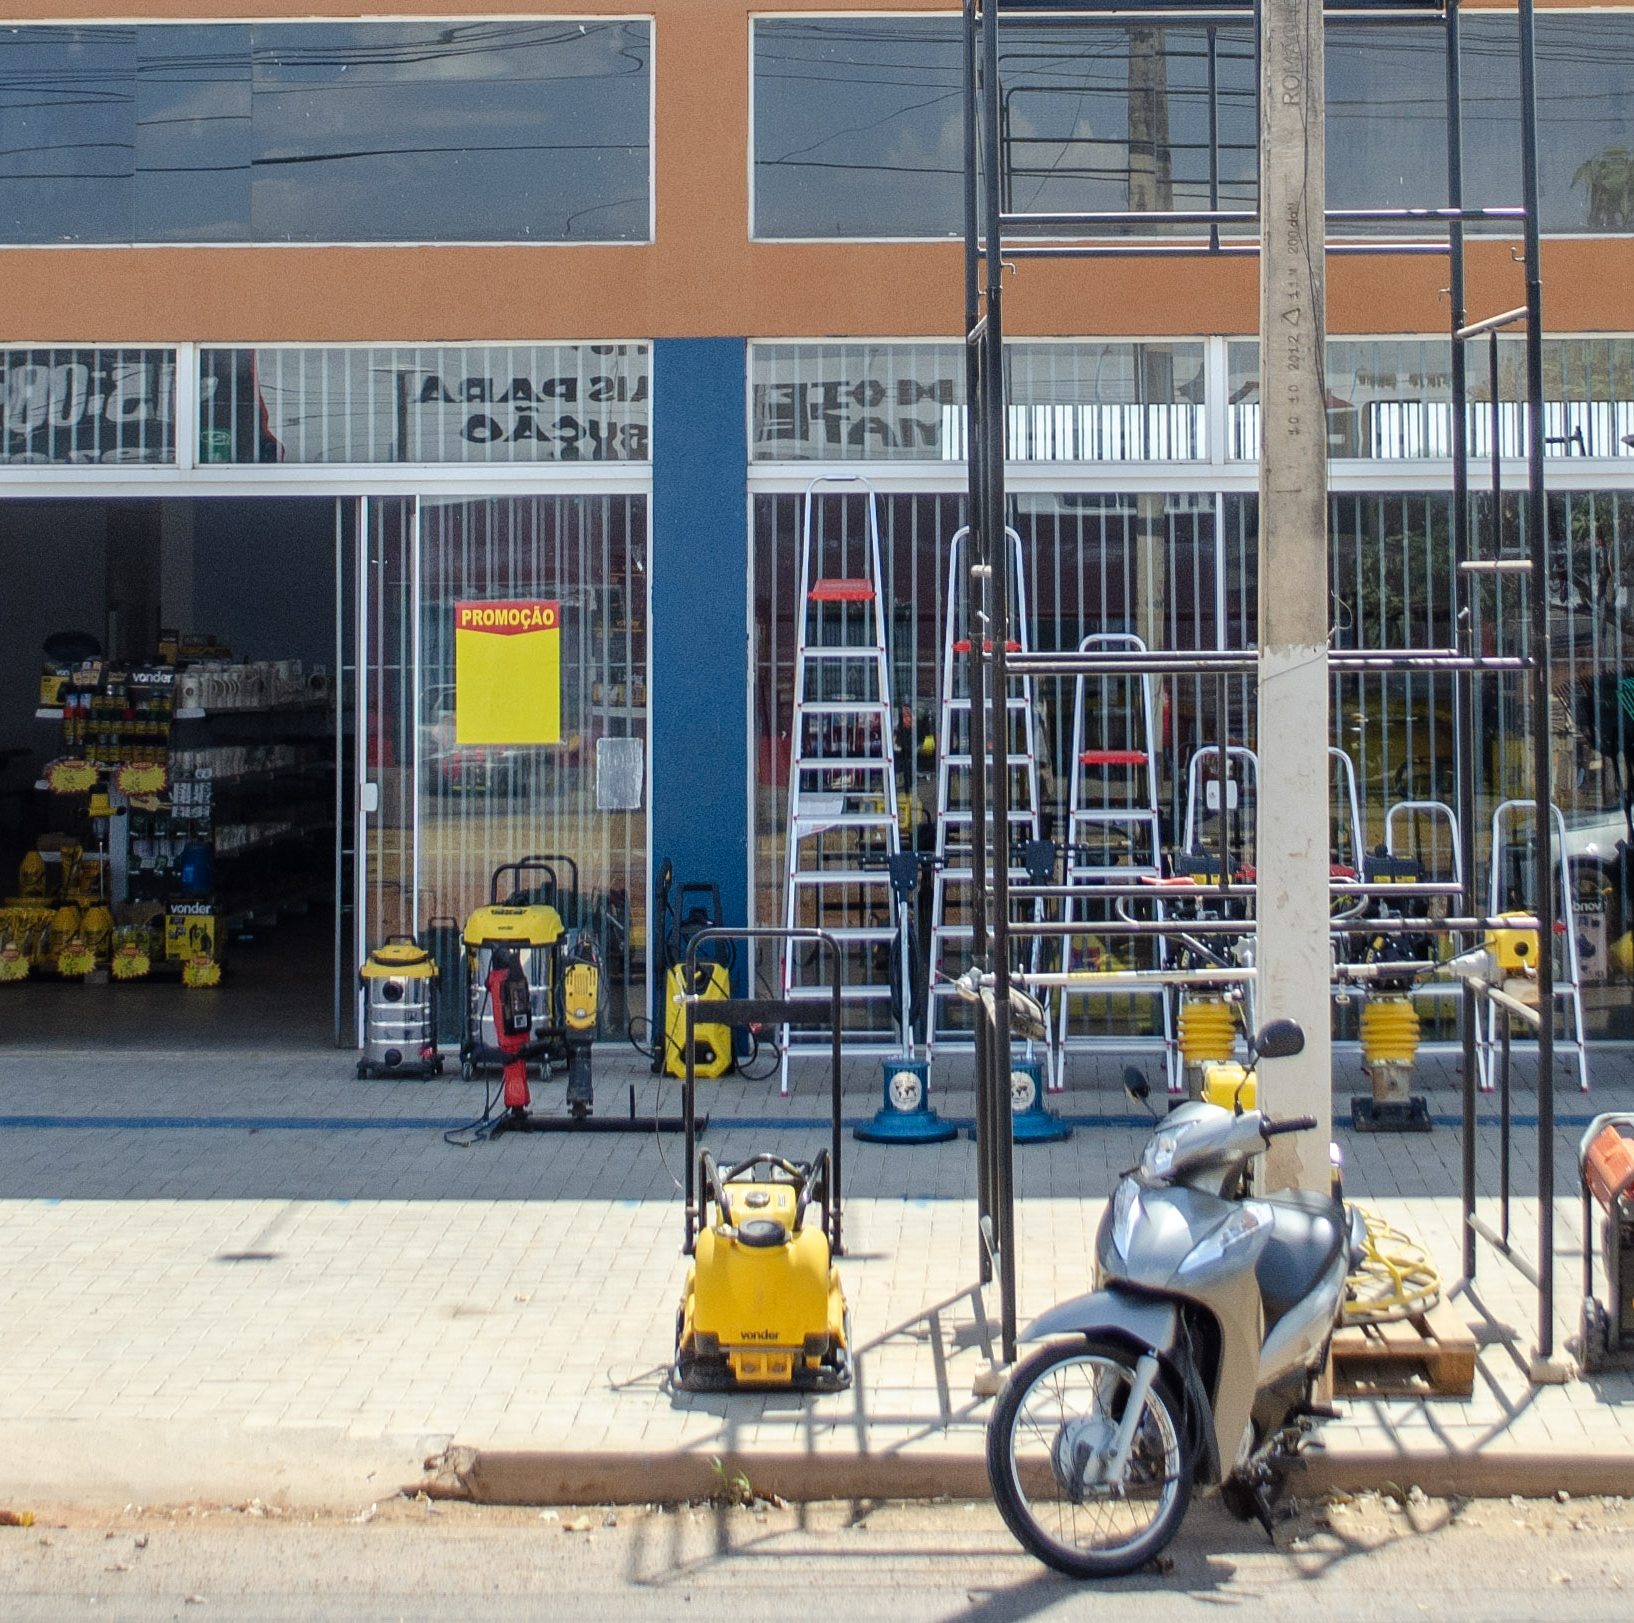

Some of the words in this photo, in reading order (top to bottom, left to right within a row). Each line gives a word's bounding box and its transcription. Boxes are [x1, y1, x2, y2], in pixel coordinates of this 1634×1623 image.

[461, 605, 555, 630] PROMOÇÃO
[132, 670, 173, 684] vonder
[170, 901, 212, 915] vonder
[740, 1327, 779, 1340] vonder
